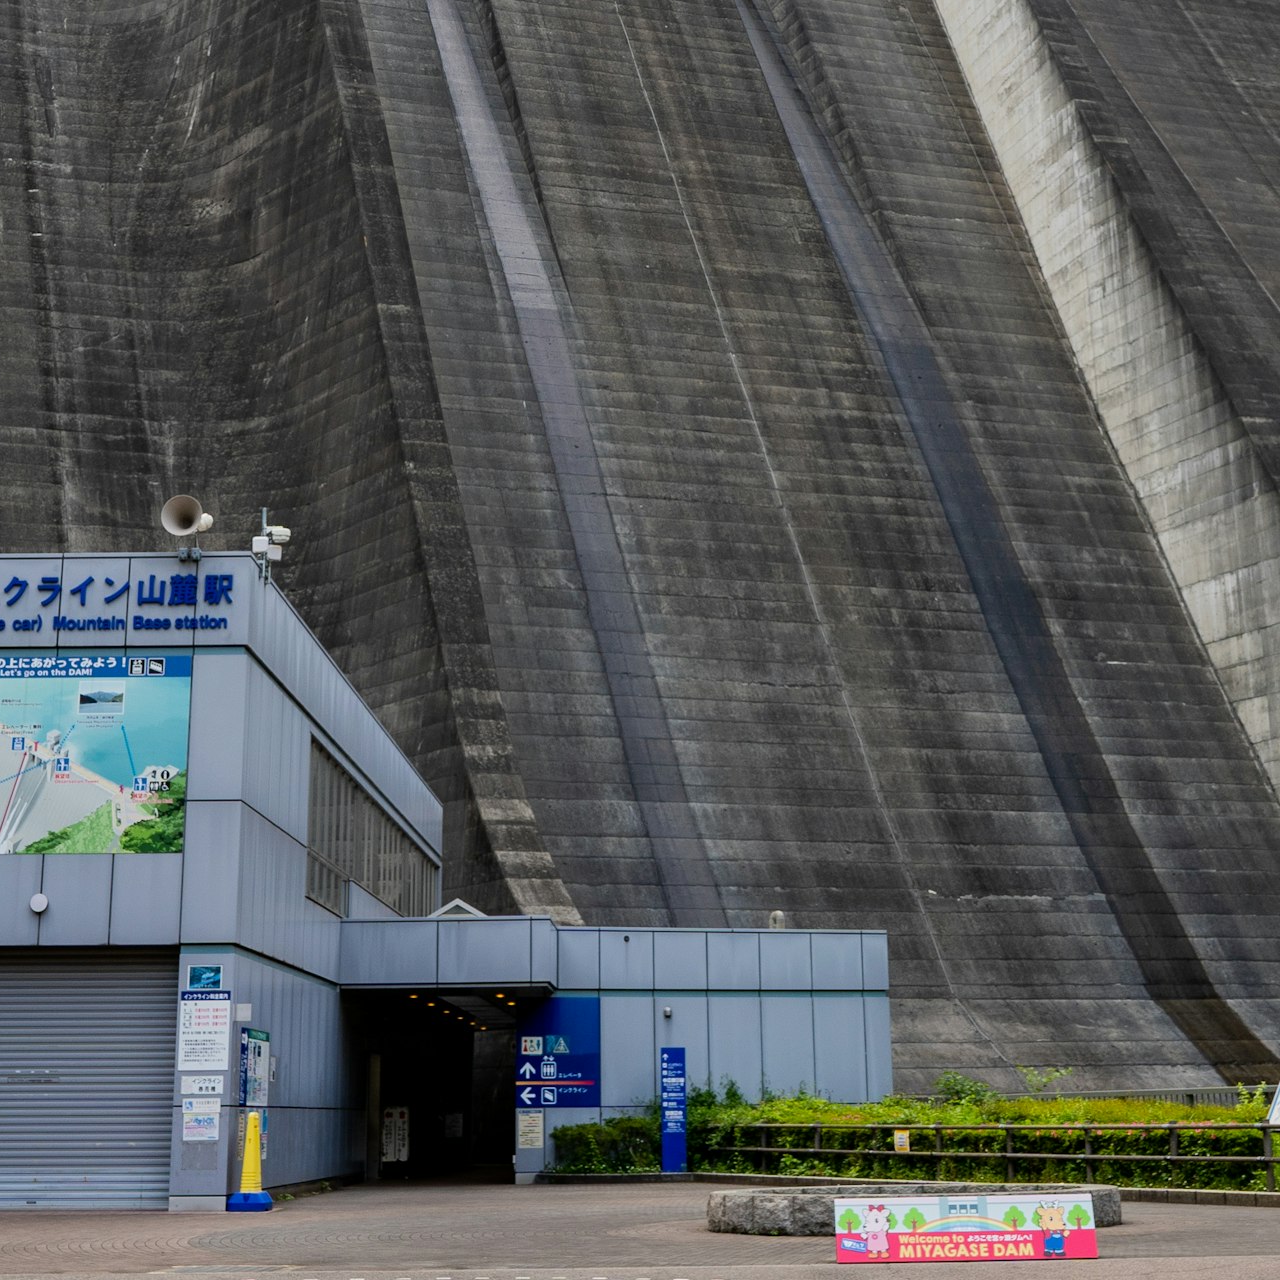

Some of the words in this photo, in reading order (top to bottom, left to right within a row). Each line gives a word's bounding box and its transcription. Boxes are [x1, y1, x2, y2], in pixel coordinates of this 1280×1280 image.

[12, 615, 42, 633] car)
[53, 616, 125, 631] Mountain
[133, 615, 171, 630] Base
[175, 615, 228, 630] station
[0, 669, 22, 677] Let's
[898, 1234, 950, 1244] Welcome
[952, 1235, 965, 1244] to
[899, 1243, 989, 1259] MIYAGASE
[993, 1242, 1035, 1257] DAM
